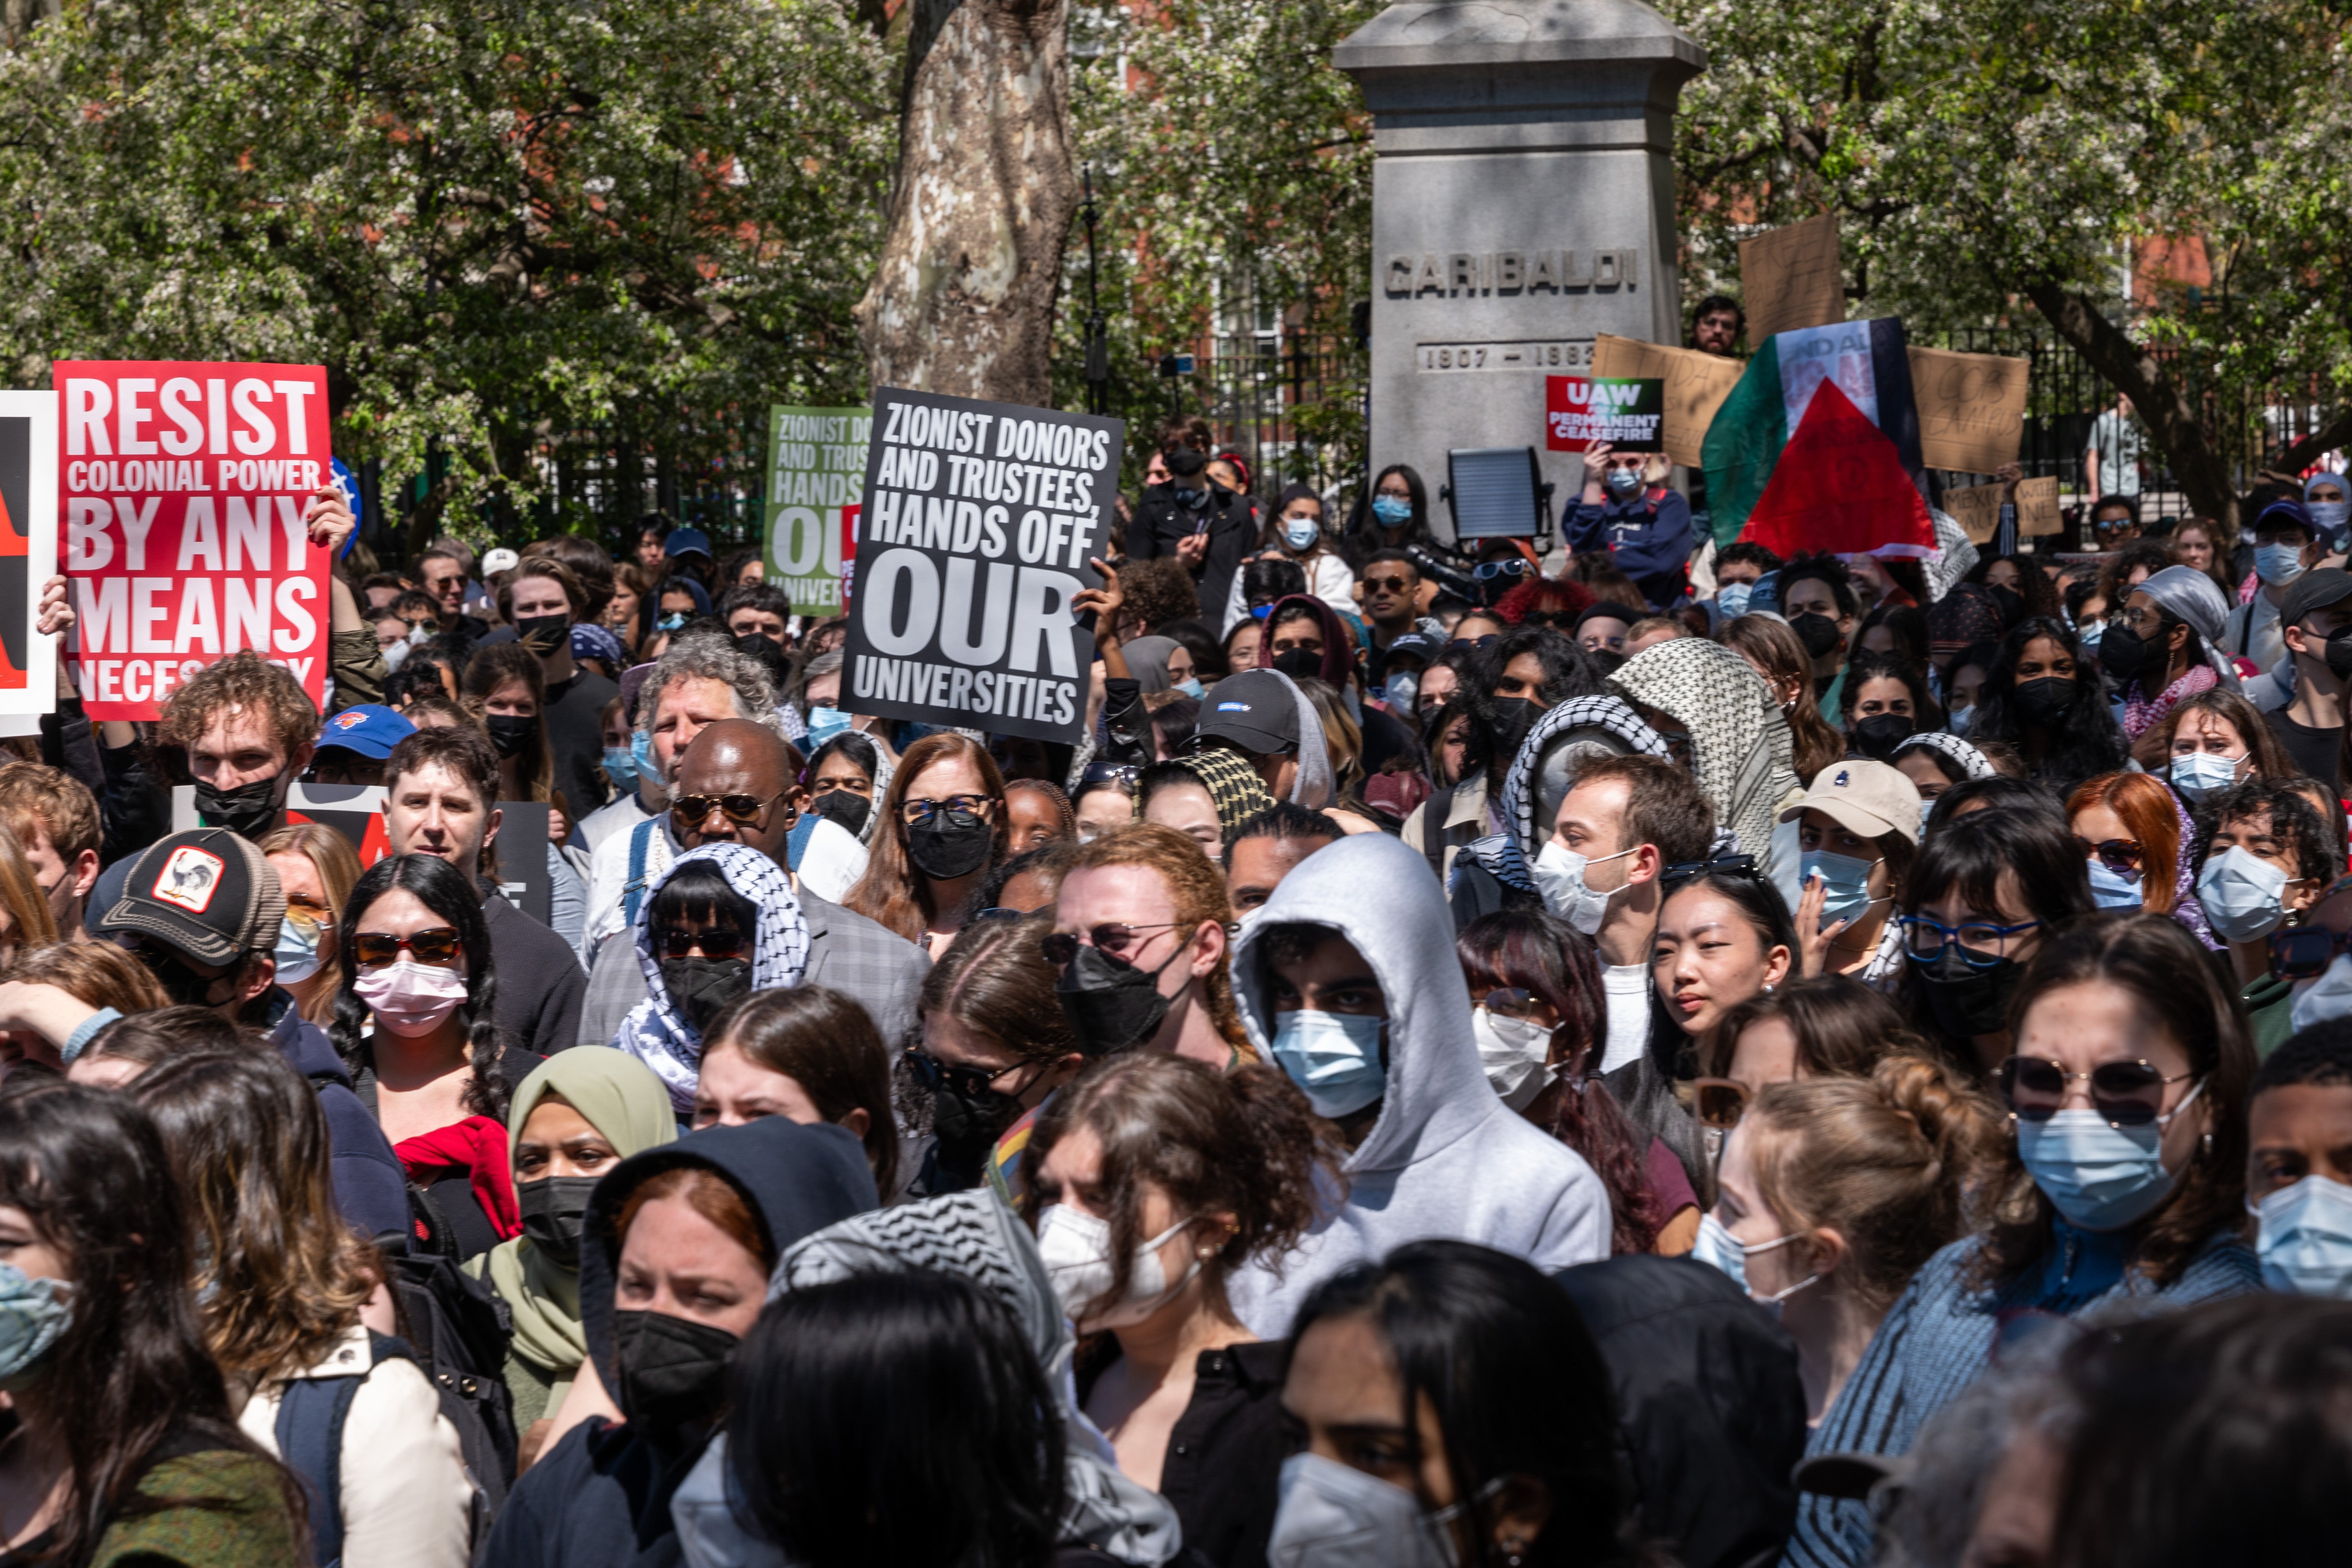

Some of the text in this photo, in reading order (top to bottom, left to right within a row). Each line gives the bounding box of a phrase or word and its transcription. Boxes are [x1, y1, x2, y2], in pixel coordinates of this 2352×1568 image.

[1385, 248, 1637, 296] GARIBALDI
[1427, 346, 1488, 368] 1807
[66, 377, 315, 455] RESIST
[1567, 382, 1642, 406] UAW
[778, 414, 847, 443] ZIONIST
[883, 403, 1110, 471] ZIONIST DONORS
[1549, 412, 1661, 428] PERMANENT
[1555, 425, 1653, 441] CEASEFIRE
[68, 460, 320, 491] COLONIAL POWER
[777, 443, 815, 470] AND
[774, 471, 864, 506] HANDS
[877, 446, 1100, 519] AND TRUSTEES,
[2019, 480, 2057, 498] WITH
[68, 496, 317, 571] BY ANY
[869, 490, 1009, 558] HANDS
[1018, 510, 1097, 569] OFF
[67, 576, 316, 654] MEANS
[863, 548, 1085, 678] OUR
[68, 656, 314, 702] NECESY
[854, 655, 1077, 725] UNIVERSITIES
